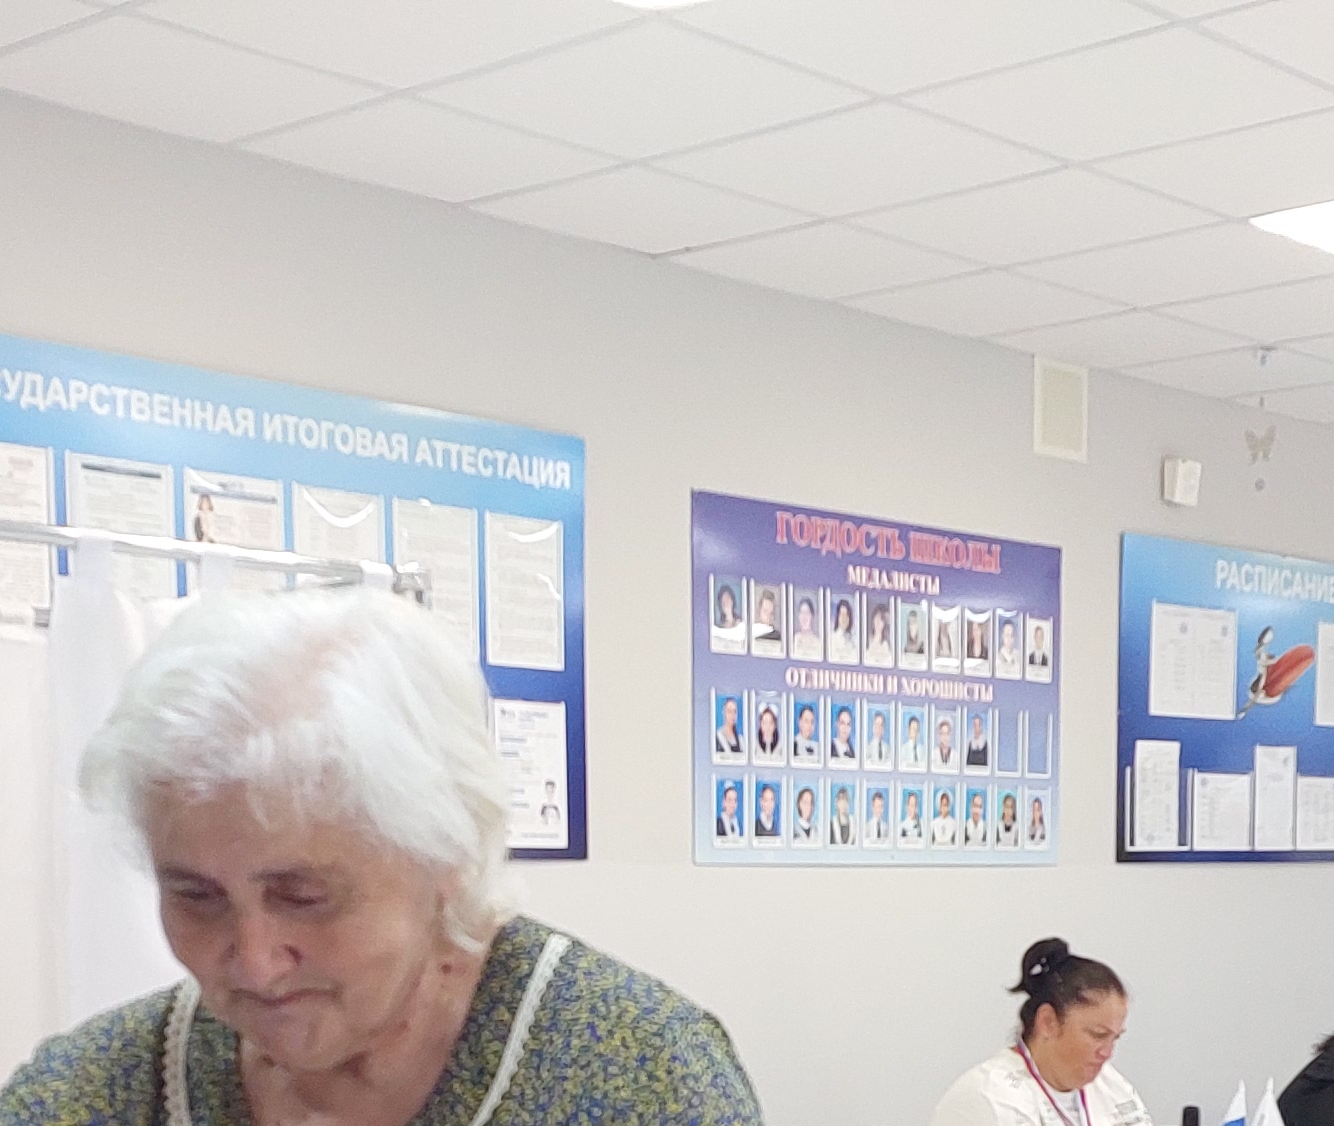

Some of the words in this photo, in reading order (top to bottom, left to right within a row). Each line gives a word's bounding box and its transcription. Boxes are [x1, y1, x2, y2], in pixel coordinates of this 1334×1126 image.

[263, 411, 408, 464] ИТОГОВАЯ
[414, 438, 570, 489] АТТЕСТАЦИЯ
[776, 511, 906, 561] ГОРДОСТЬ
[909, 531, 1002, 574] ШКОЛЫ
[847, 565, 940, 596] МЕДАЛИСТЫ
[785, 667, 884, 695] ОТЛИЧНИКИ
[887, 678, 898, 696] И
[900, 678, 994, 703] ХОРОШИСТЫ
